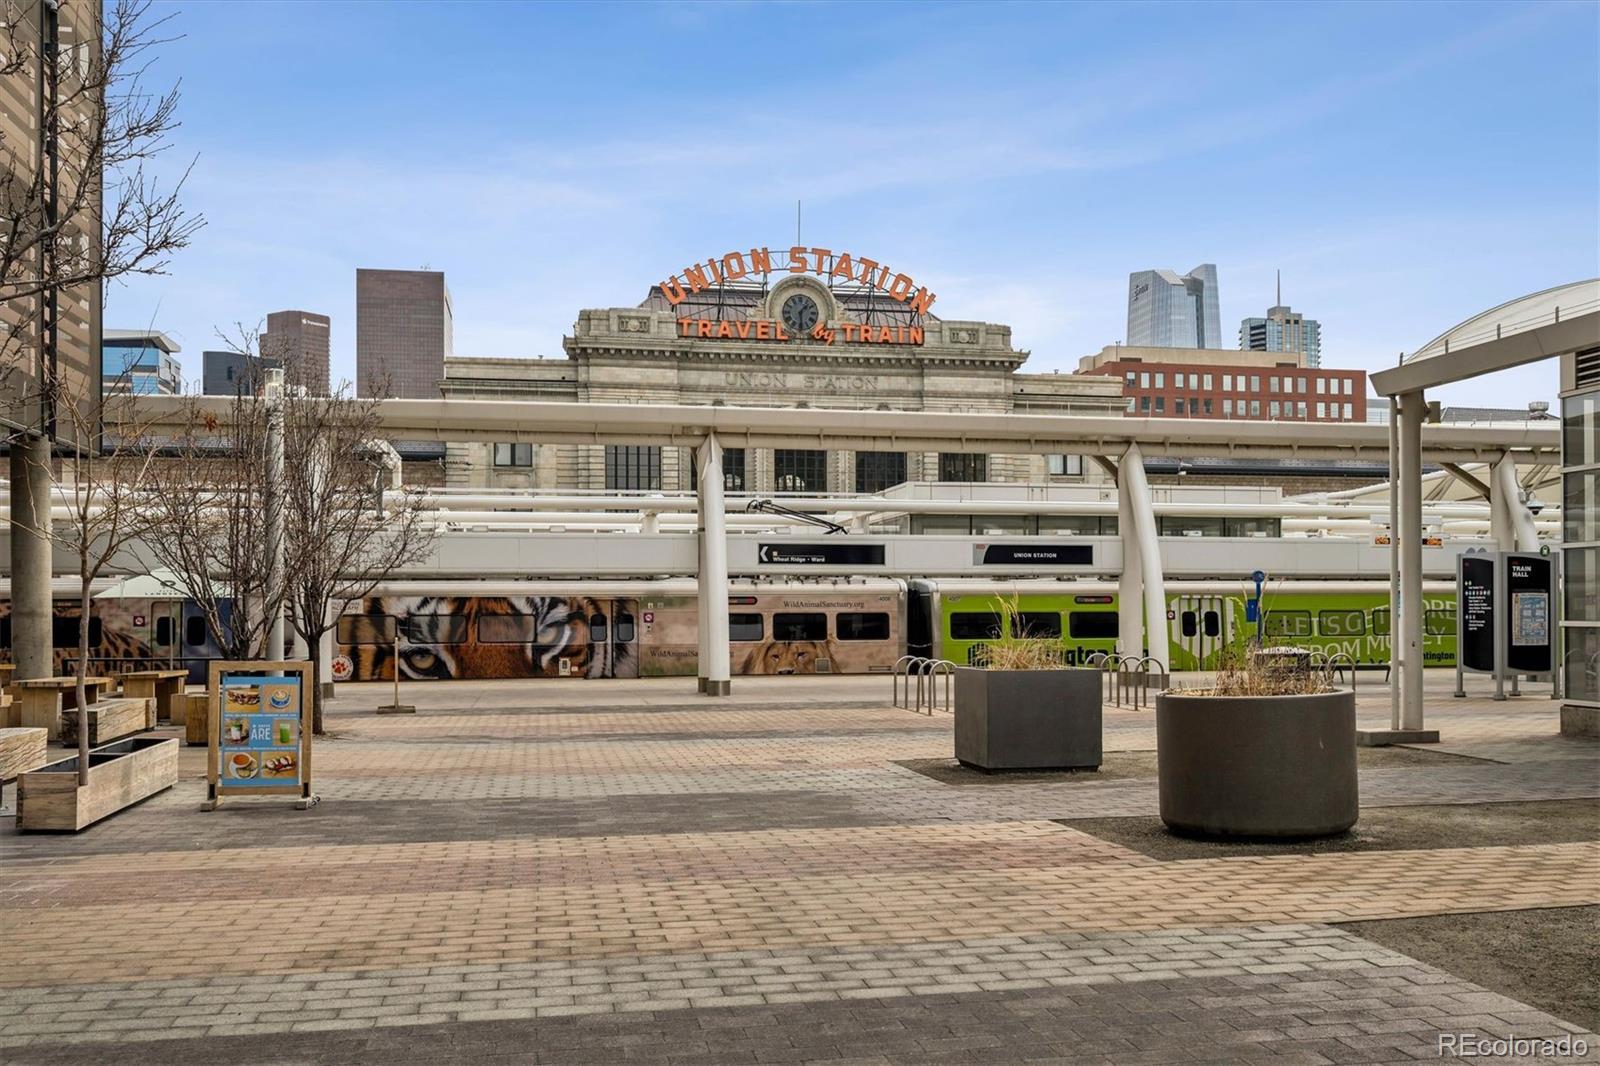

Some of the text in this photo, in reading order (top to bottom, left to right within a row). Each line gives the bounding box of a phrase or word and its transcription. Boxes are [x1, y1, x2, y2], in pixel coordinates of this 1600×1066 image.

[659, 246, 936, 316] UNION STATION
[677, 318, 925, 346] TRAVEL by TRAIN
[725, 373, 879, 390] UNION STATION
[783, 600, 865, 609] WildAnimalSanctuary.org
[1282, 614, 1340, 637] LET'S
[1345, 604, 1389, 633] GET
[1423, 651, 1455, 662] ntington
